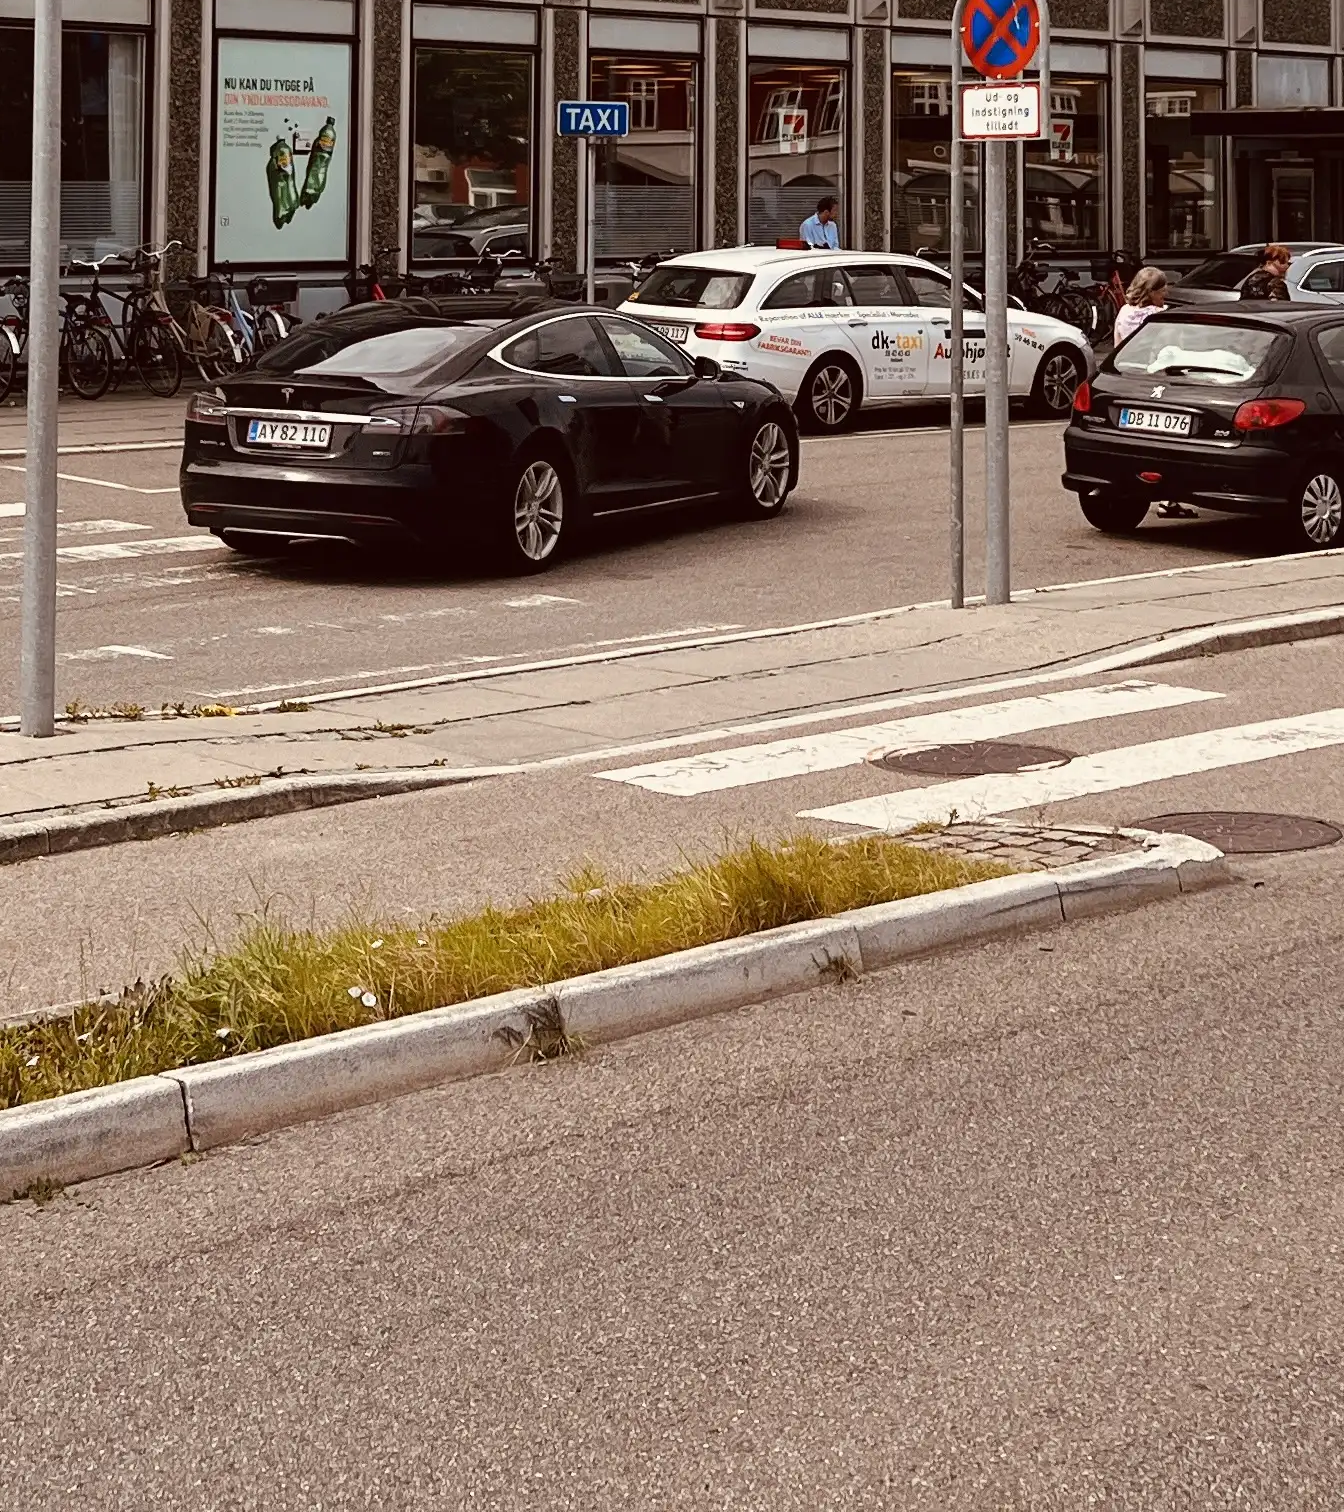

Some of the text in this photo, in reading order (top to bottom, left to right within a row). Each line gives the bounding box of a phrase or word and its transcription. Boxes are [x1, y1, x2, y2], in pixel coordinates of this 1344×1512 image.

[224, 76, 315, 93] NU KAN DU TYGGE PÅ
[1006, 93, 1019, 103] og
[565, 108, 619, 131] TAXI
[986, 121, 1019, 131] tilladt
[807, 311, 824, 319] ALLE
[670, 328, 686, 338] 117
[871, 329, 924, 350] dk-taxi
[934, 342, 1011, 363] Auhjøt
[1128, 411, 1189, 431] DB 11 076
[258, 423, 327, 443] AY 82 110
